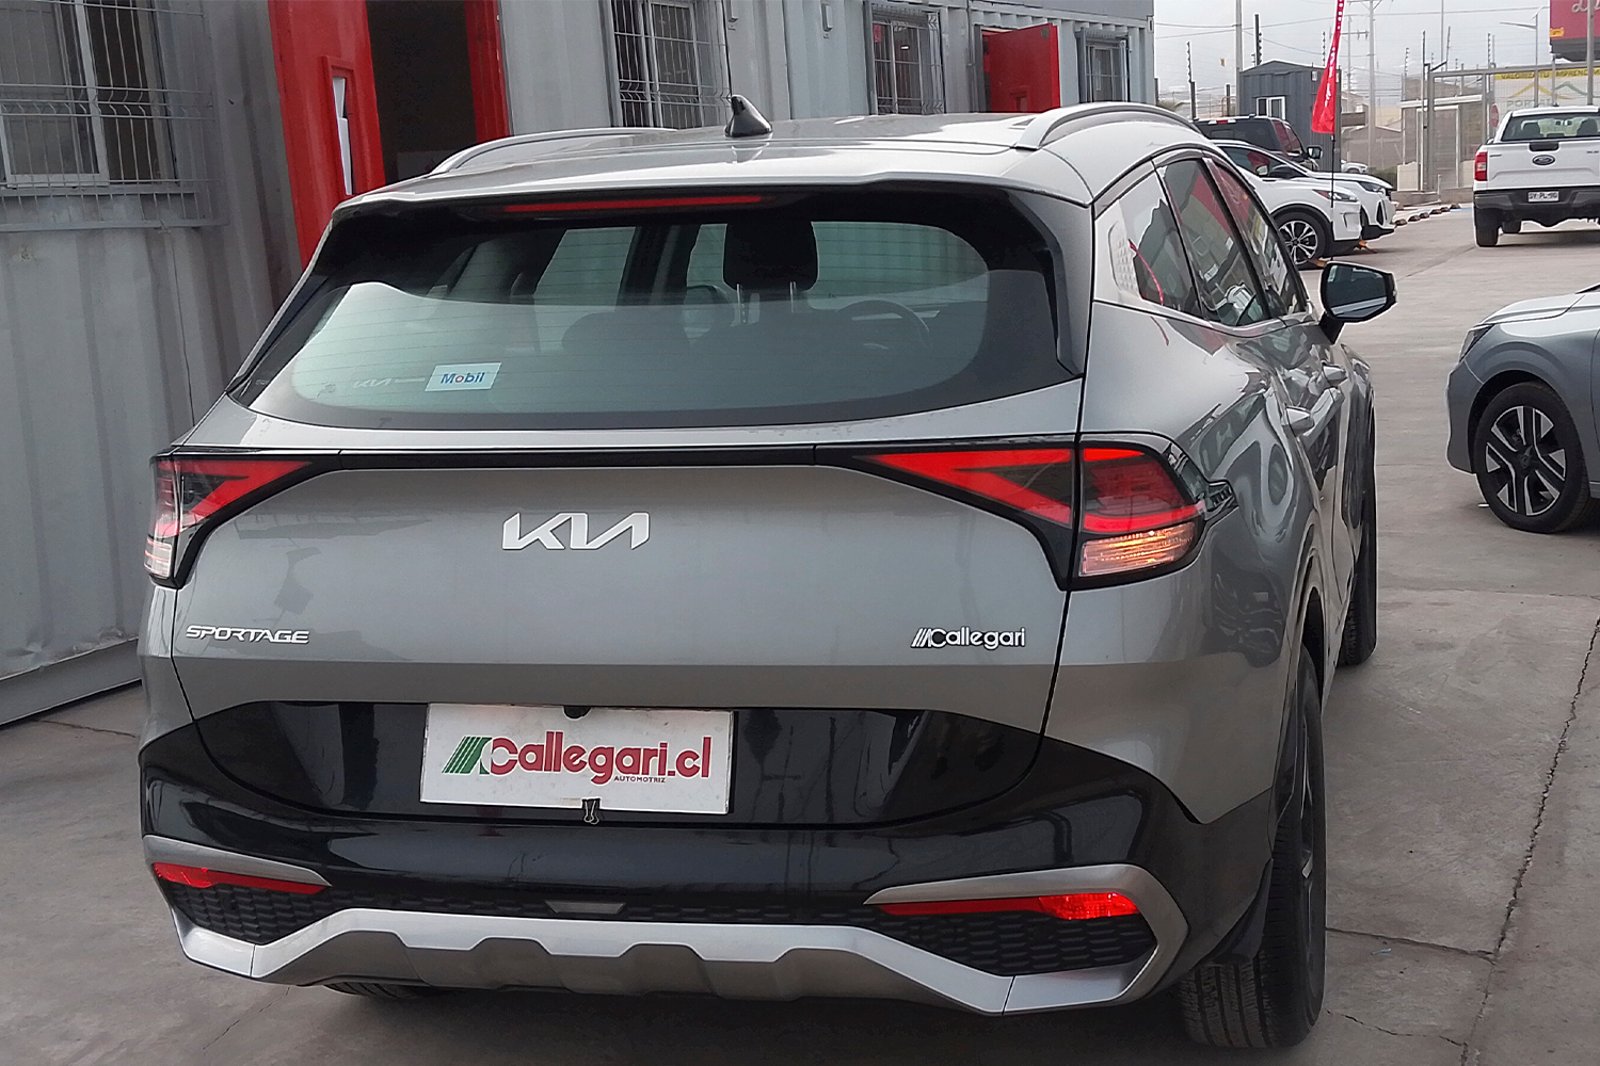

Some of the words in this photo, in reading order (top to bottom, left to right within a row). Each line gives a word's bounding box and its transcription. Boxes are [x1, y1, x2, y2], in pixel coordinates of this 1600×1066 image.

[440, 372, 485, 385] Mobil
[501, 512, 651, 551] KIA
[185, 625, 310, 644] SPORTAGE
[928, 626, 1026, 650] Callegari
[488, 731, 712, 786] Callegari.cl
[613, 775, 666, 783] AUTOMOTRIZ
